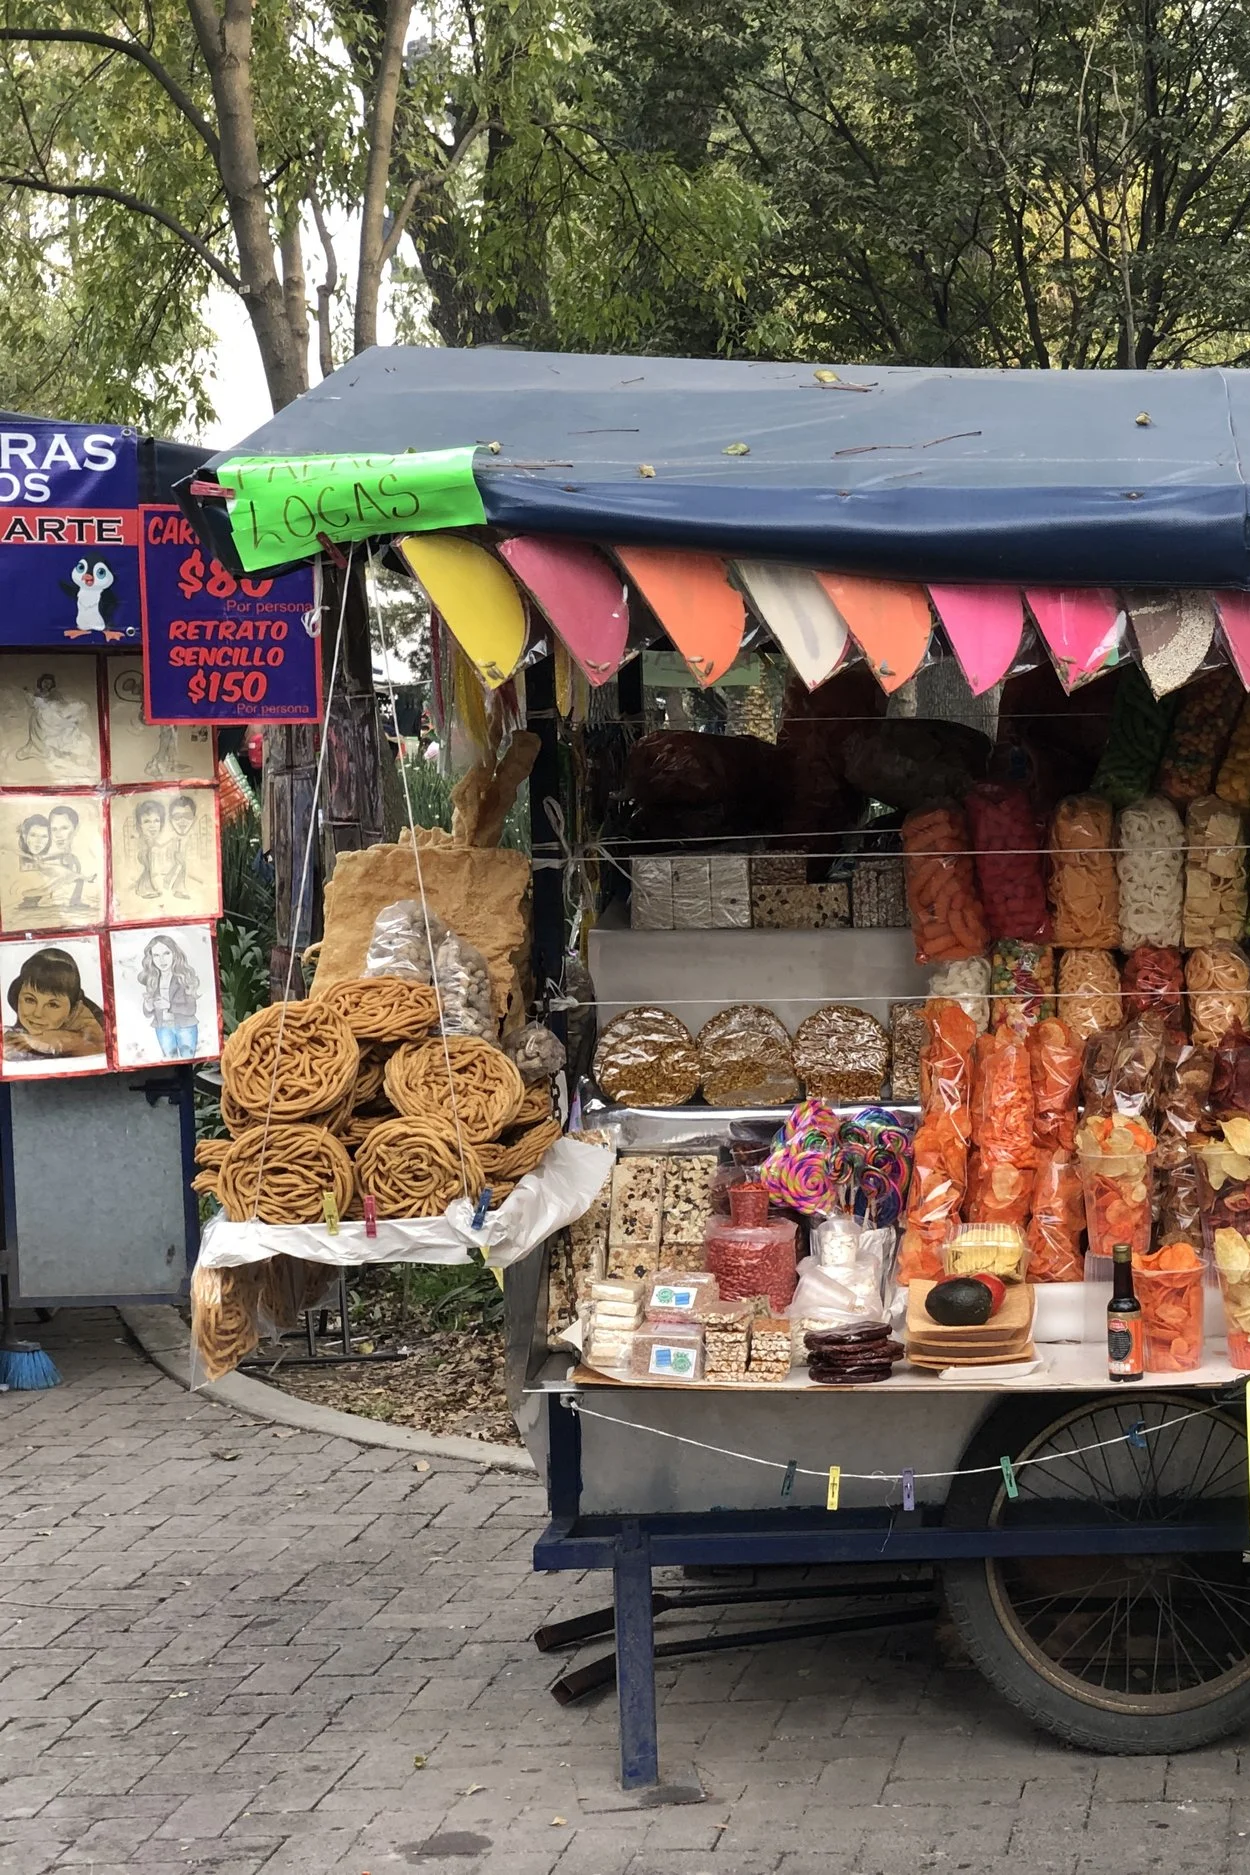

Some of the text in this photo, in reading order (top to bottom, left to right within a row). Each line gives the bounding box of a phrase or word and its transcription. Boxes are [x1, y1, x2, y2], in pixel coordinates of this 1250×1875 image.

[249, 473, 421, 550] LOCAS
[2, 516, 123, 544] ARTE
[226, 601, 313, 615] Por persona
[168, 620, 289, 641] RETRATO
[168, 646, 285, 667] SENCILLO
[187, 668, 268, 704] $150
[237, 703, 310, 716] Por persona
